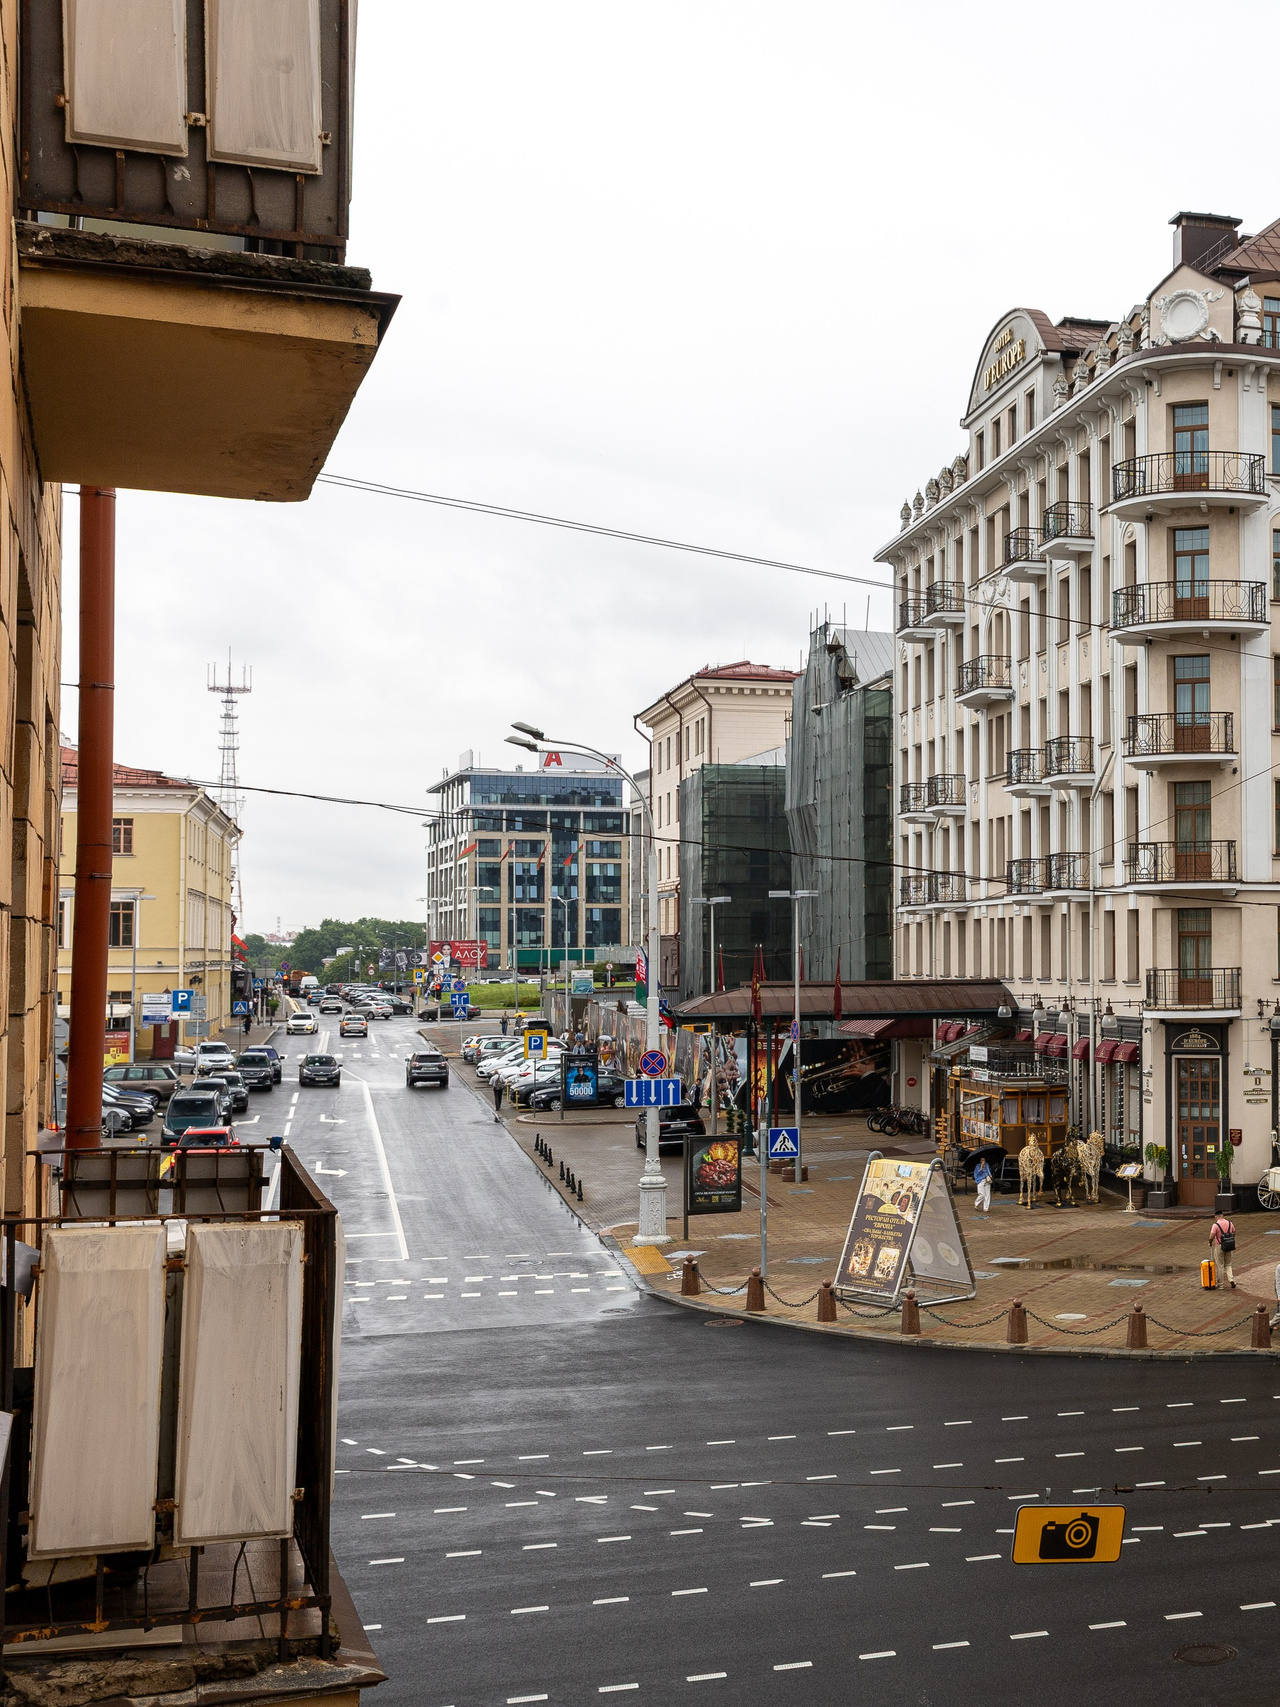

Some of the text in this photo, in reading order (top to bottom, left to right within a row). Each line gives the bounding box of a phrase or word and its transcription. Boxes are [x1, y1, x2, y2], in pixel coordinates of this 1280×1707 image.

[993, 328, 1013, 353] HOTEL
[983, 338, 1025, 391] D'EUROPE
[454, 949, 486, 959] АЛСУ
[569, 1087, 593, 1096] 50000
